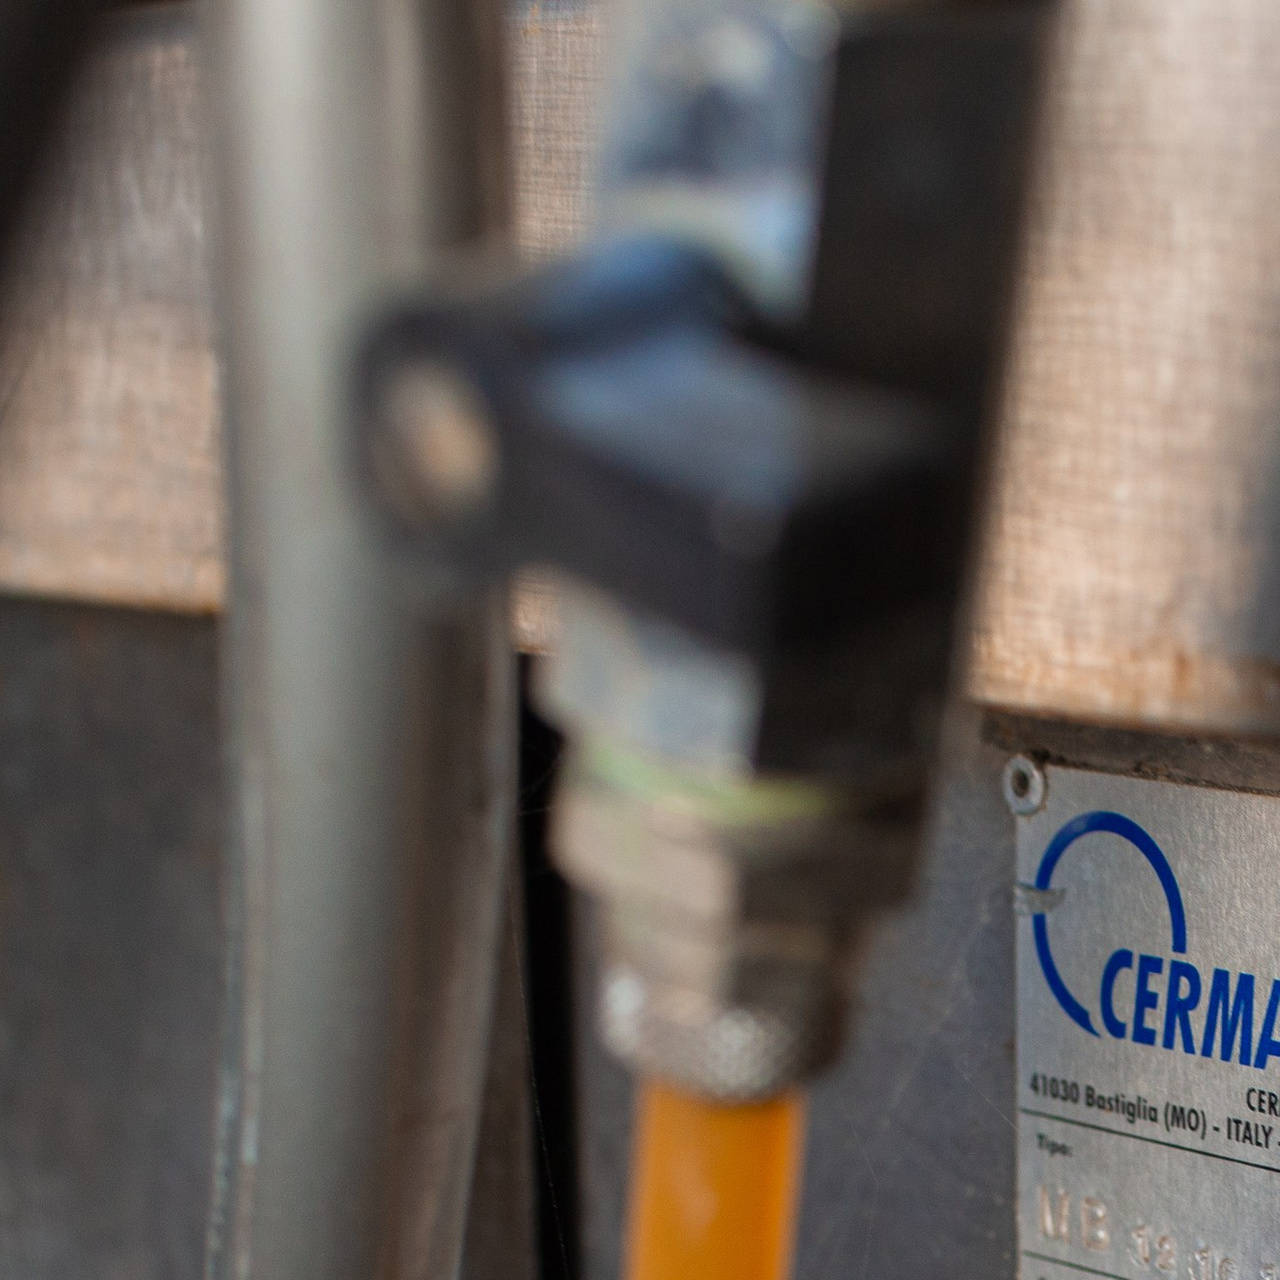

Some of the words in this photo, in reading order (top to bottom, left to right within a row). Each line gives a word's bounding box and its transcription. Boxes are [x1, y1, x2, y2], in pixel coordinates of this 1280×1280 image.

[1030, 1073, 1079, 1105] 41030
[1085, 1086, 1158, 1124] Bastiglia
[1164, 1102, 1207, 1139] (MO)
[1227, 1117, 1274, 1149] ITALY
